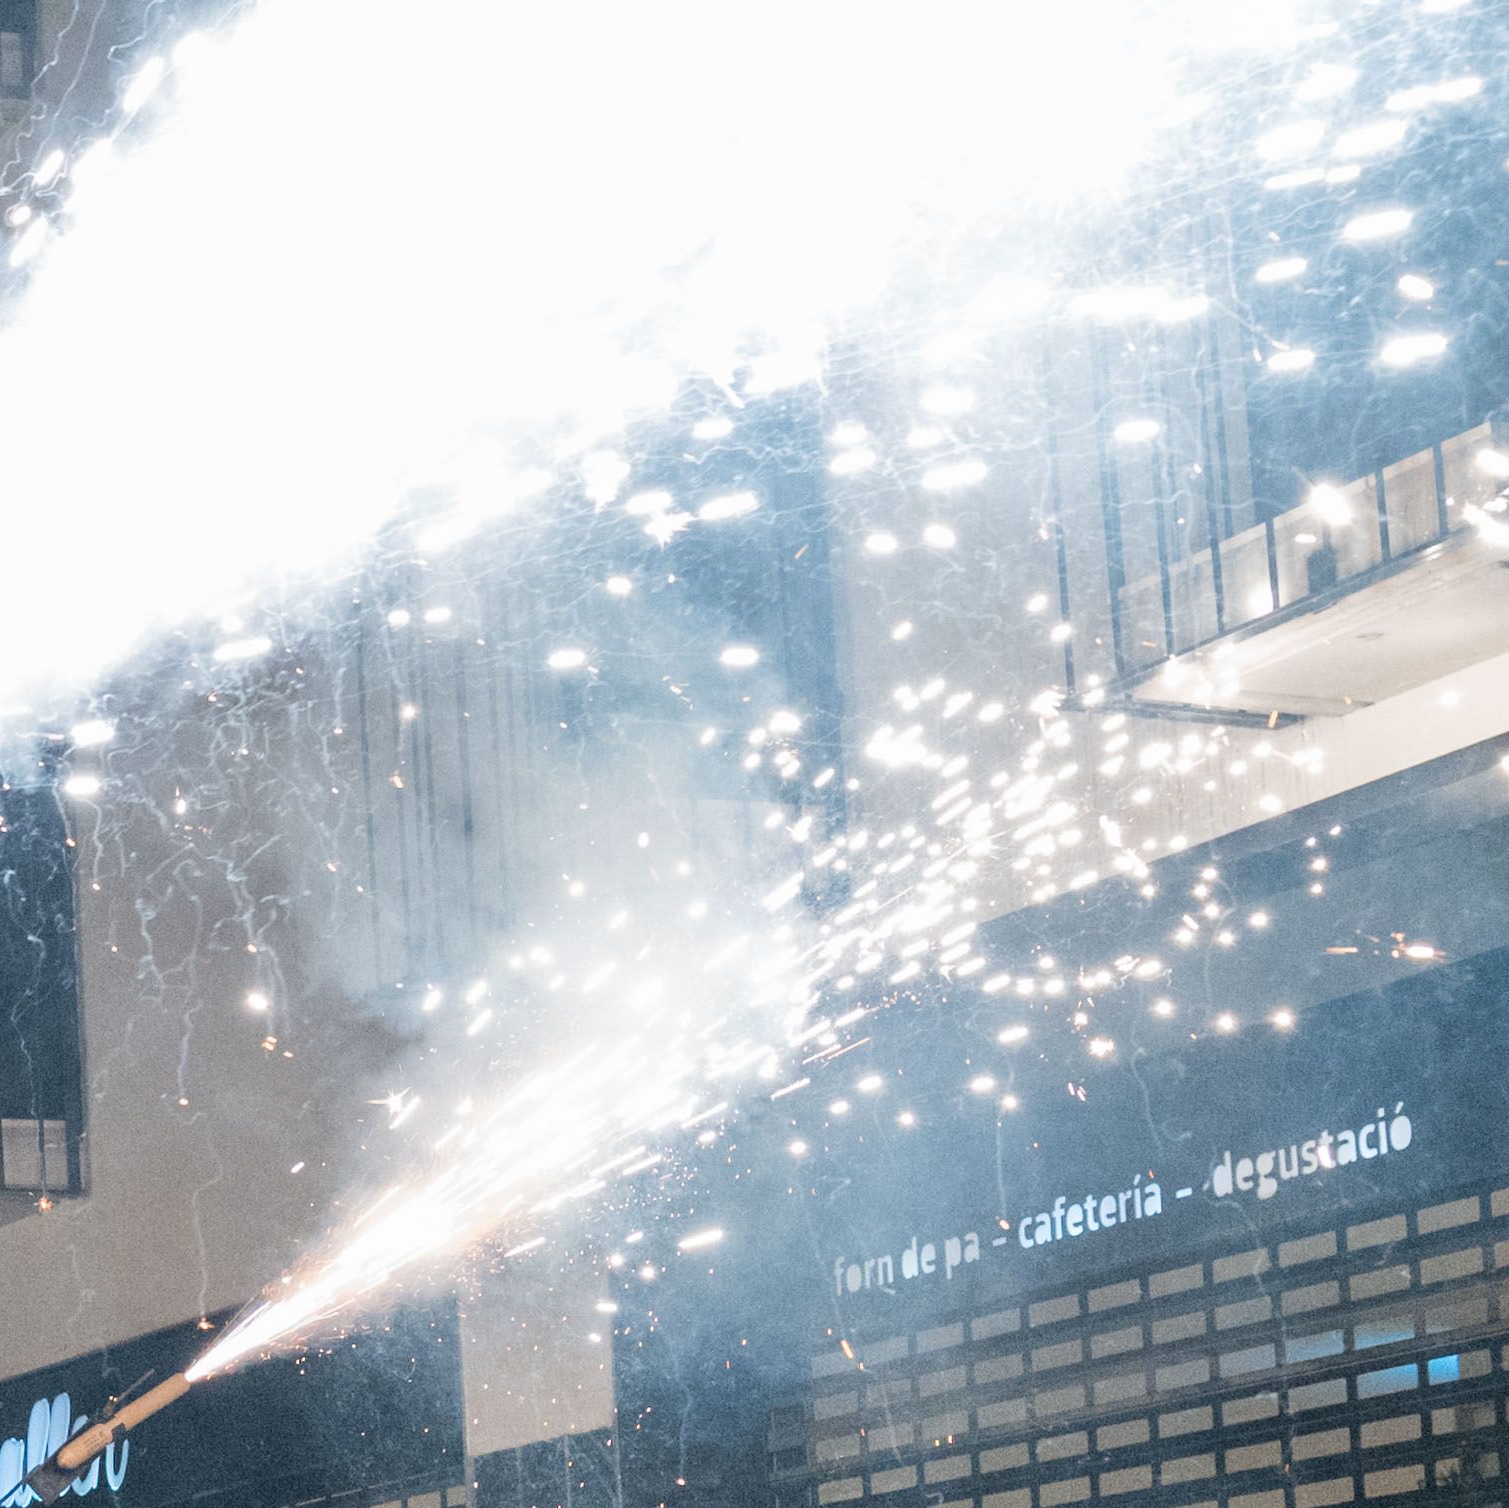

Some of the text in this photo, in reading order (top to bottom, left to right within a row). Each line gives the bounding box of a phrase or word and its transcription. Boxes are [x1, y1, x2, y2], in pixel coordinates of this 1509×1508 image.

[834, 1253, 894, 1297] forn
[901, 1236, 937, 1280] de
[944, 1231, 980, 1280] pa
[1018, 1173, 1163, 1249] cafetería
[1212, 1100, 1412, 1200] degustació
